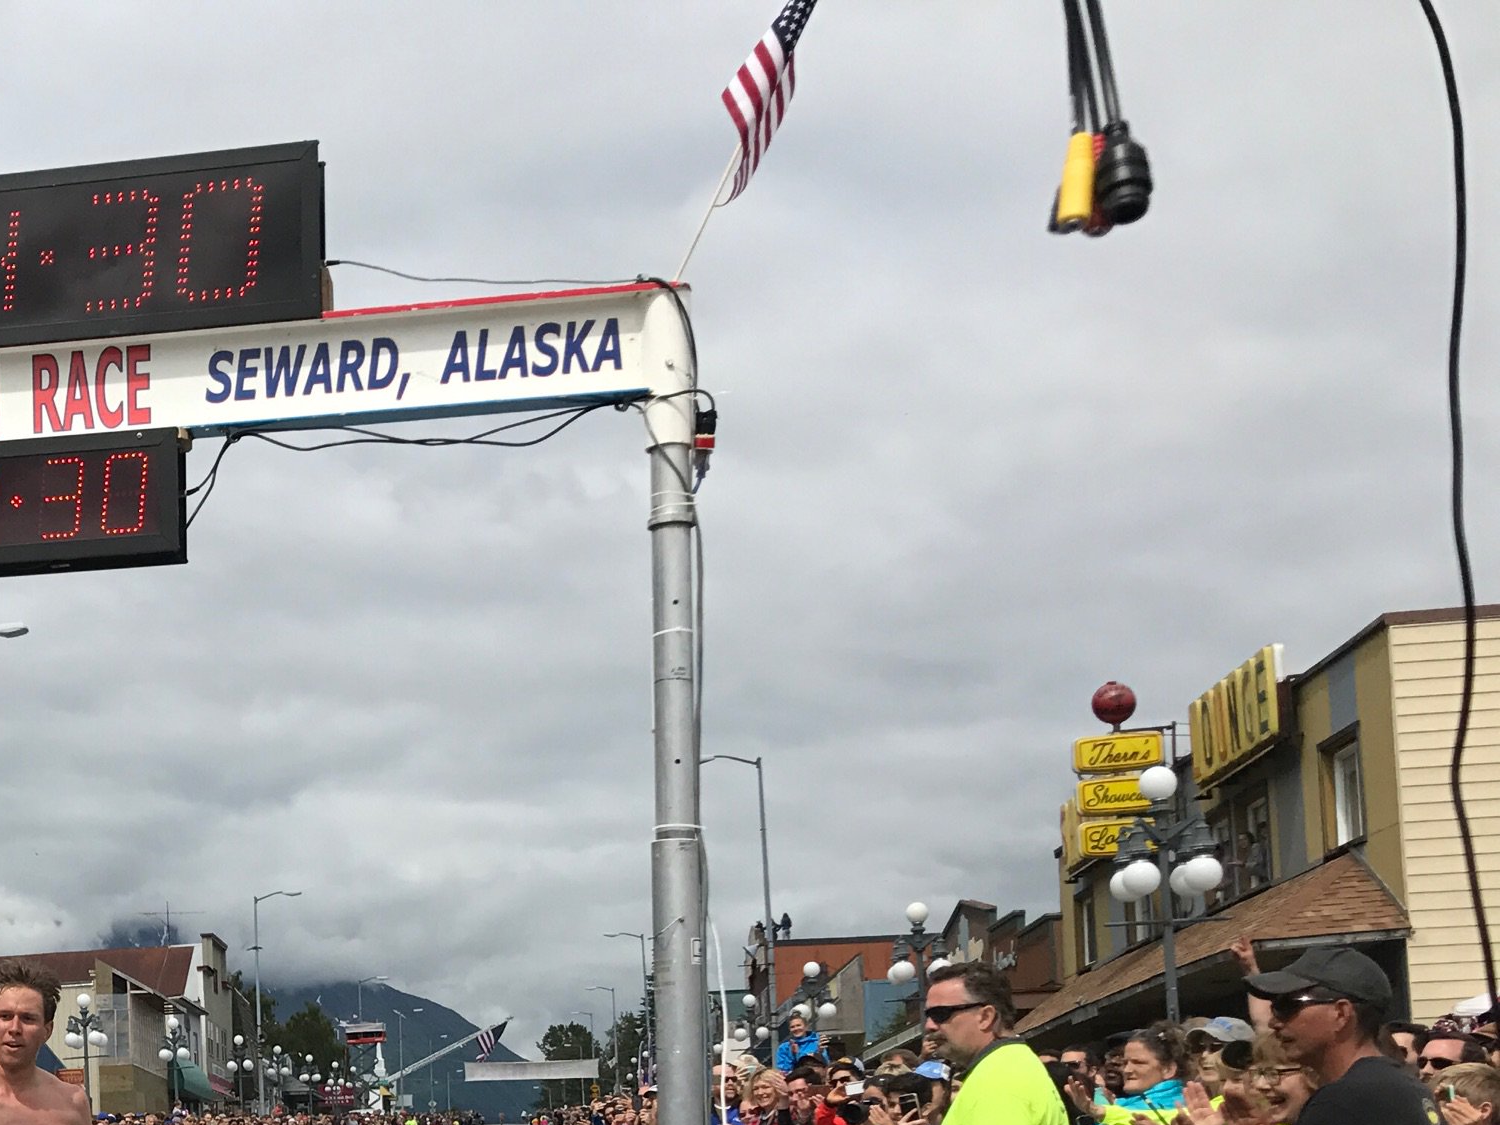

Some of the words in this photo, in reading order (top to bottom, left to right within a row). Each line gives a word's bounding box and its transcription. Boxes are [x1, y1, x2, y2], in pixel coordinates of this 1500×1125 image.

[33, 343, 152, 435] RACE
[205, 336, 411, 404] SEWARD,
[440, 317, 623, 385] ALASKA
